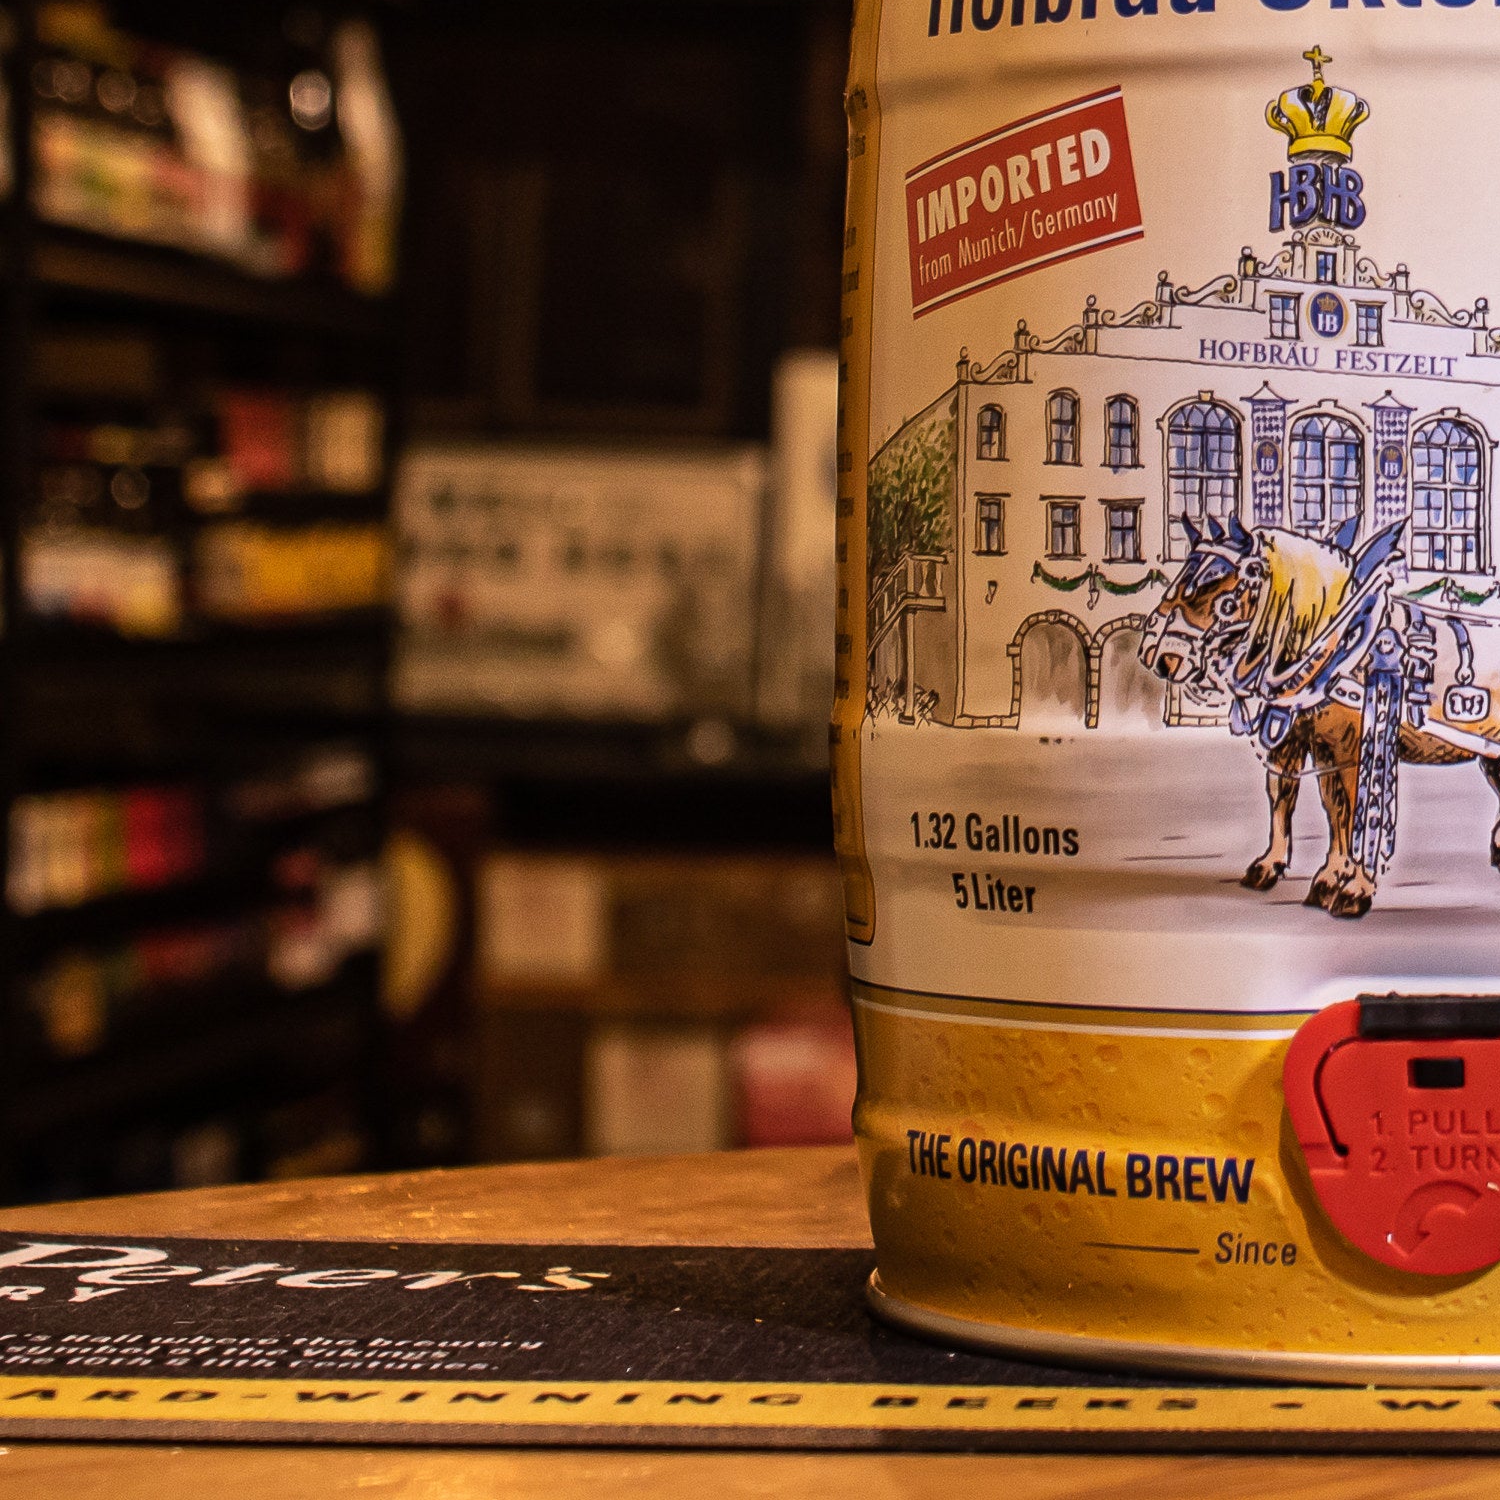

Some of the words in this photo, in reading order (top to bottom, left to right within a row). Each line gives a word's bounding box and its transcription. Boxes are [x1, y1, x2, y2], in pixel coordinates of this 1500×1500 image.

[916, 128, 1111, 244] IMPORTED
[919, 254, 951, 285] from
[958, 192, 1118, 269] Munich/Germany
[1199, 339, 1319, 367] HOFBRÄU
[1335, 349, 1458, 377] FESTZELT
[910, 812, 957, 850] 1.32
[965, 812, 1080, 856] Gallons
[971, 873, 1036, 913] Liter
[906, 1129, 951, 1180] THE
[957, 1137, 1117, 1197] ORIGINAL
[1125, 1152, 1255, 1204] BREW
[1214, 1231, 1298, 1267] Since
